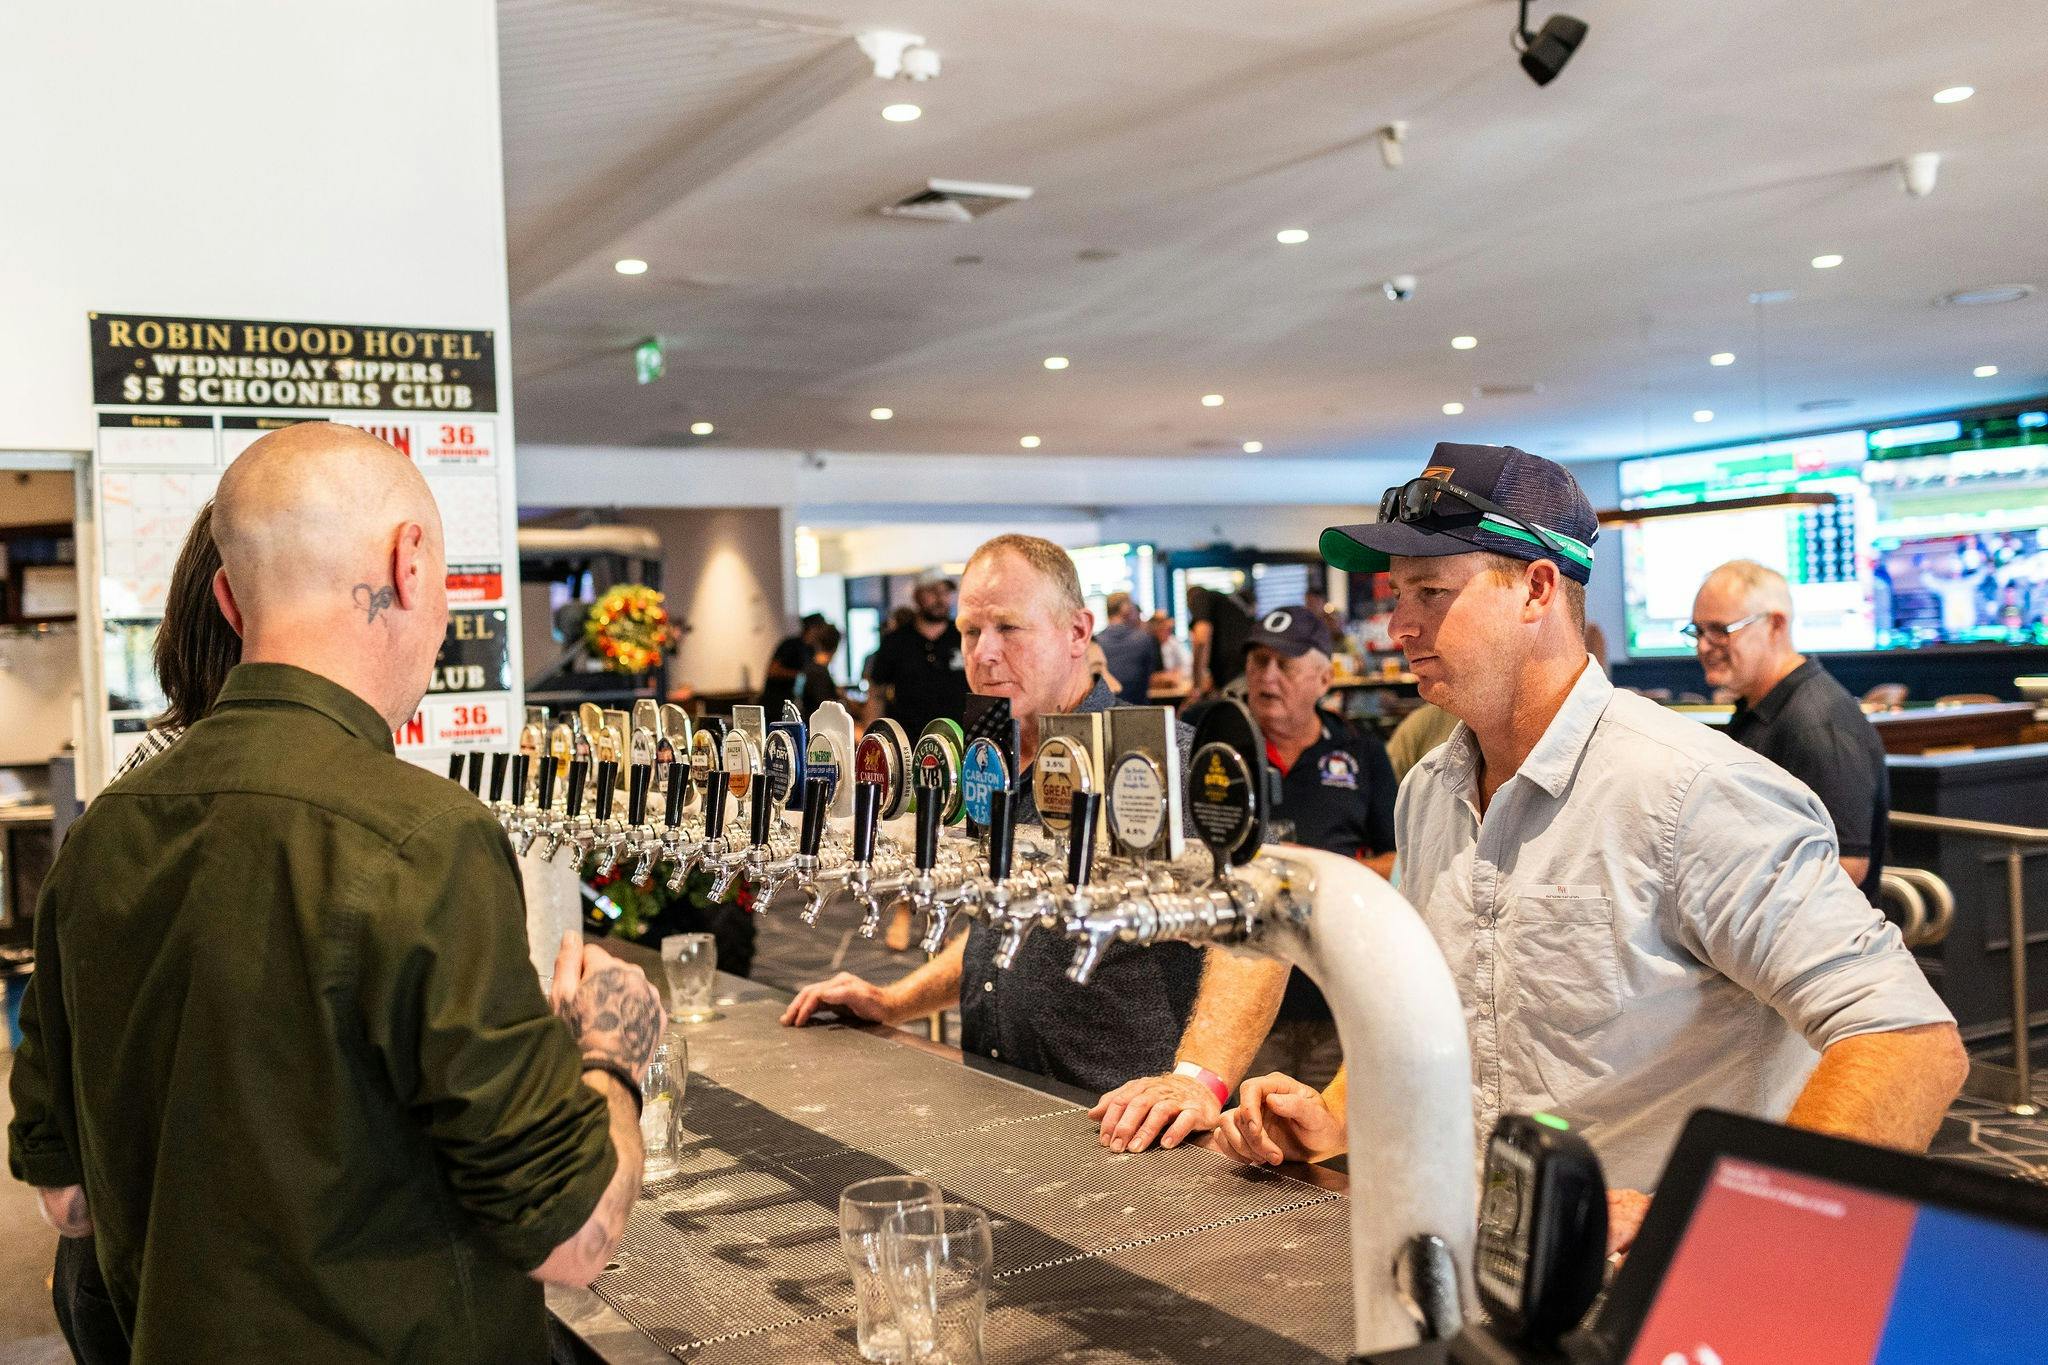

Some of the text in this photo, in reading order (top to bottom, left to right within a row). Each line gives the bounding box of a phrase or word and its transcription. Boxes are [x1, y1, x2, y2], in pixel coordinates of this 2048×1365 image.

[109, 320, 481, 361] ROBIN HOOD HOTEL
[152, 354, 328, 380] WEDNESDAY
[123, 373, 472, 409] $5 SCHOONERS CLUB
[440, 424, 475, 445] 36
[453, 704, 487, 726] 36
[914, 742, 946, 768] VICTORIA
[860, 771, 885, 782] CARLTON
[922, 767, 941, 788] VB
[965, 769, 999, 785] CARLTON
[1043, 784, 1072, 797] GREAT
